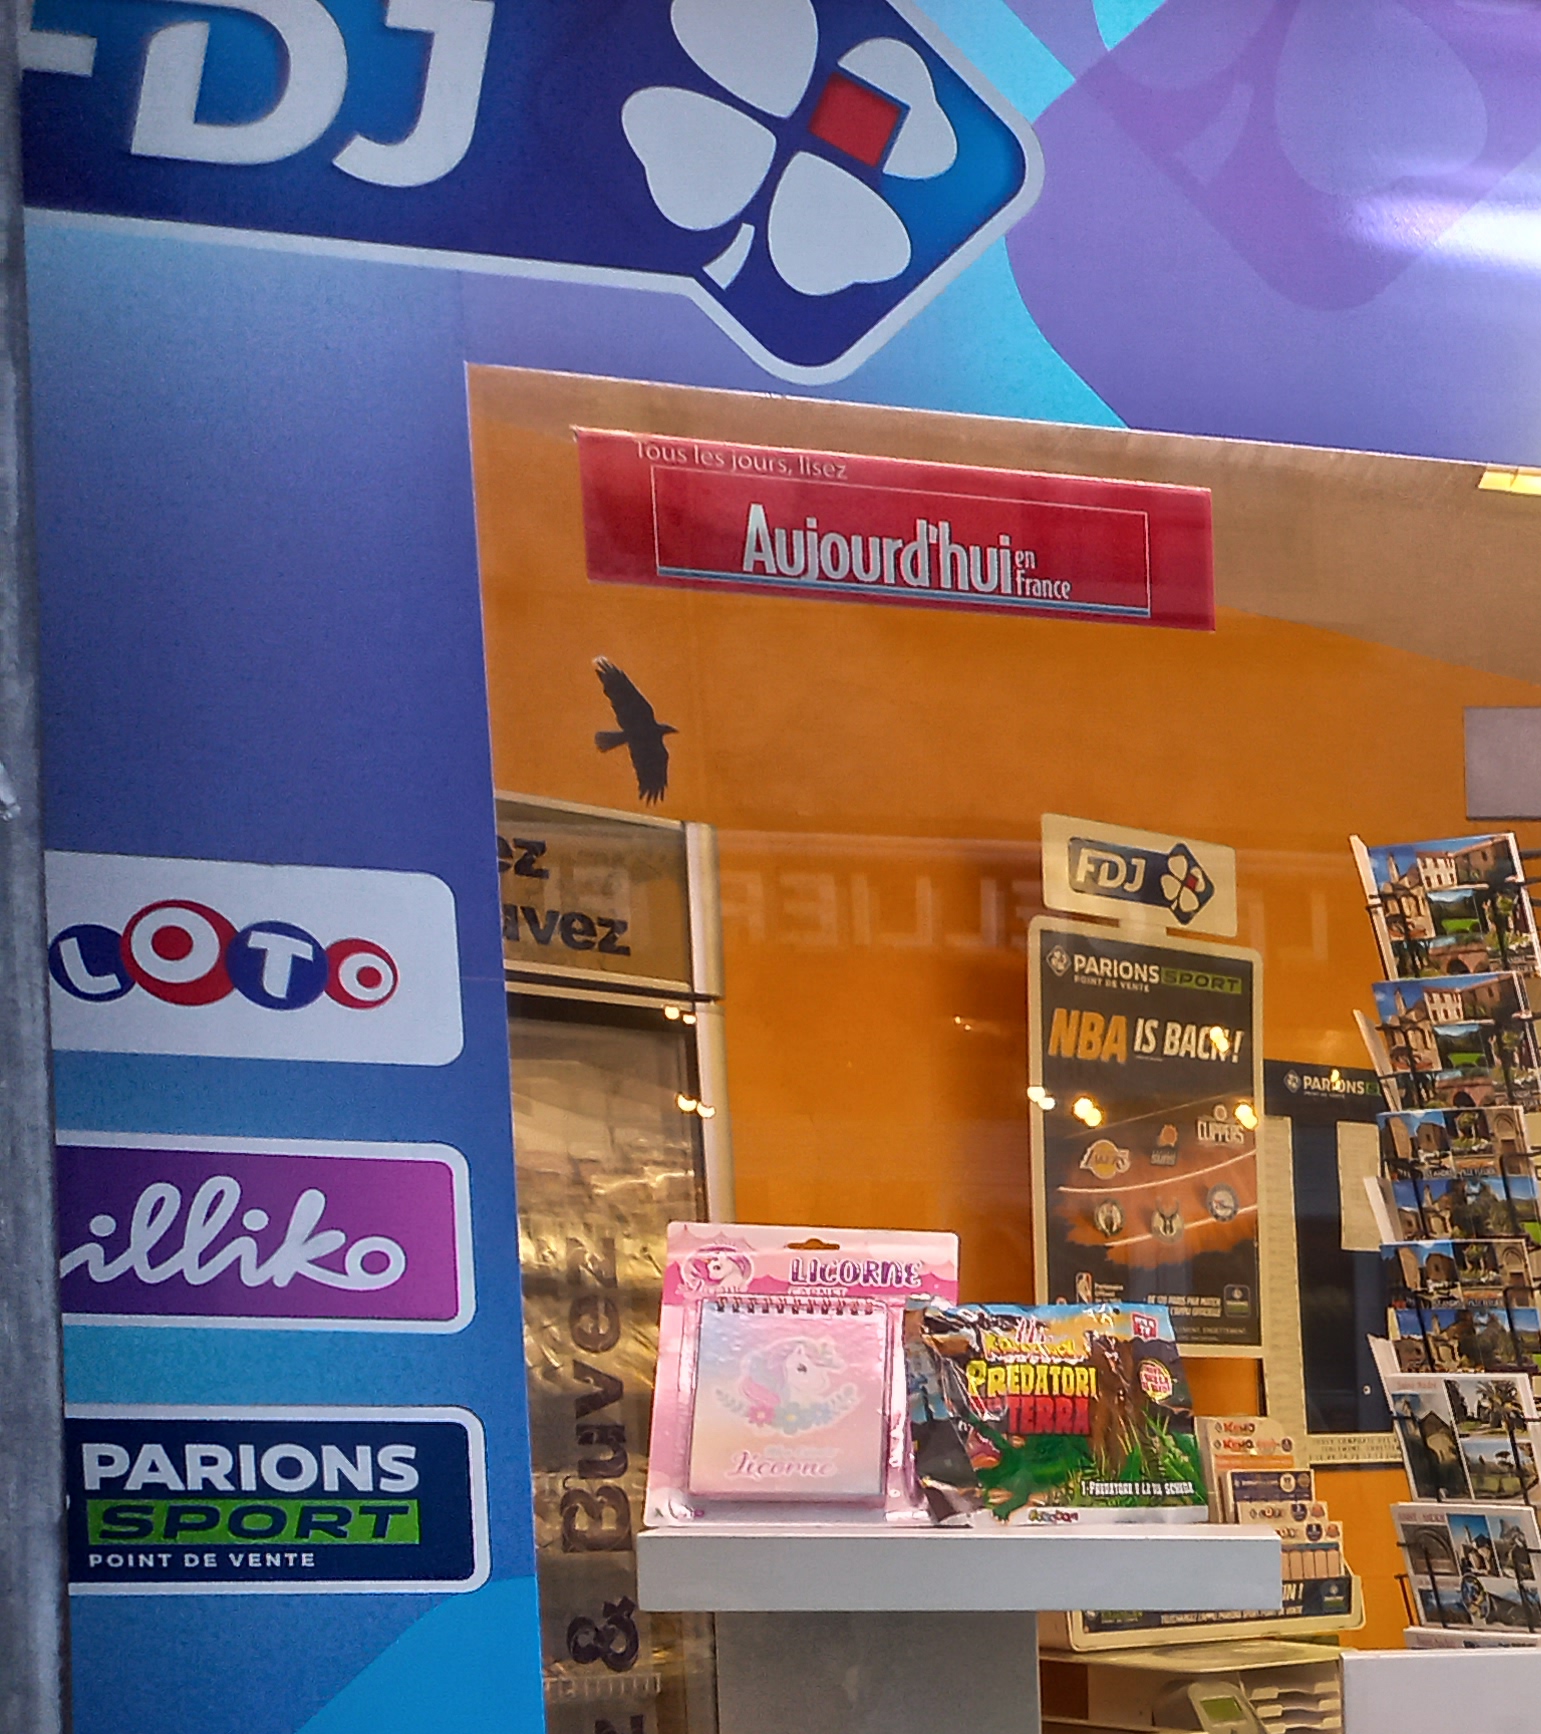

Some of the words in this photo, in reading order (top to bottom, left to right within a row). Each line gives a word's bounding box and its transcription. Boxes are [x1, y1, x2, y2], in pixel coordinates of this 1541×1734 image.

[636, 441, 687, 465] Tous
[692, 444, 725, 467] les
[729, 447, 792, 477] jours,
[797, 454, 848, 480] lisez
[742, 503, 1013, 595] Aujourd'hui
[1014, 549, 1036, 569] en
[1016, 572, 1072, 600] France
[1076, 847, 1147, 893] FDJ
[50, 899, 399, 1010] LOTO
[1073, 954, 1161, 985] PARIONS
[1163, 969, 1240, 994] SPORT
[1047, 1006, 1129, 1064] NBA
[1133, 1017, 1158, 1054] IS
[60, 1176, 406, 1291] illiko
[790, 1256, 925, 1288] LICORNE
[560, 1235, 632, 1553] Buvez
[965, 1359, 1100, 1399] PREDATORI
[80, 1443, 420, 1493] PARIONS
[724, 1450, 839, 1481] Licorne
[97, 1503, 411, 1541] SPORT
[88, 1553, 173, 1568] POINT
[183, 1553, 218, 1568] DE
[228, 1552, 316, 1568] VENTE
[566, 1596, 640, 1673] &
